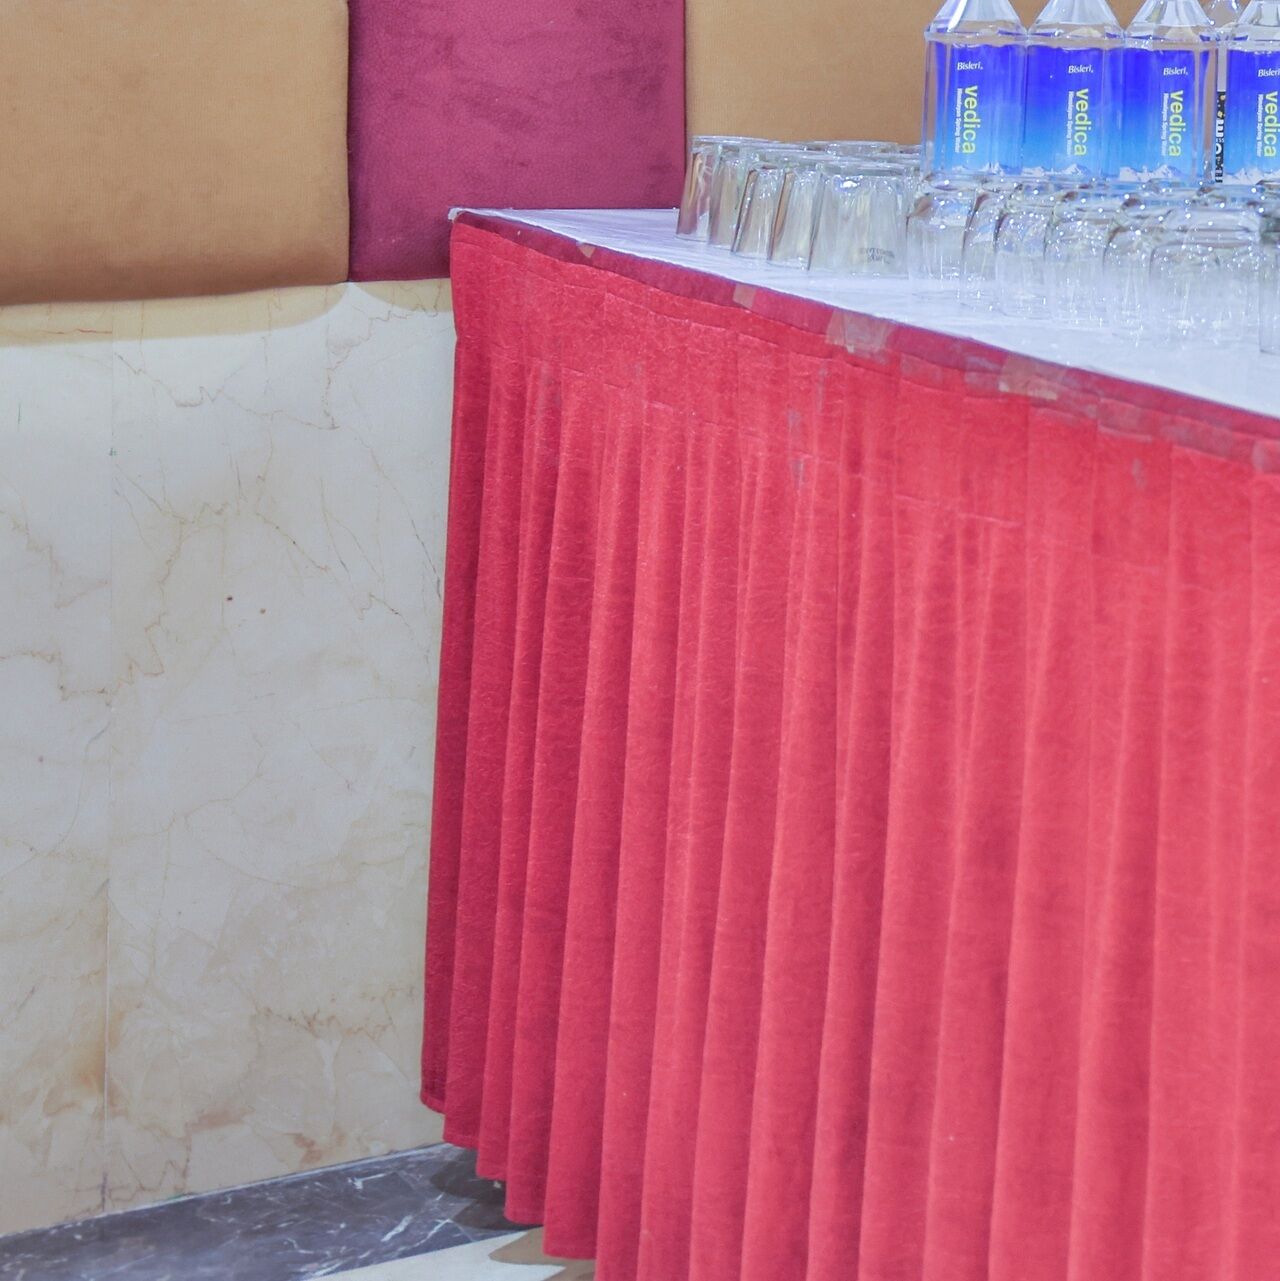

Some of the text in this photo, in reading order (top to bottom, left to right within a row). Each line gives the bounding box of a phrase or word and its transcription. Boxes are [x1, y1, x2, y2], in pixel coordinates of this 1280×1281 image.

[957, 61, 981, 70] Bisleri
[1068, 64, 1091, 73] Bisleri
[1163, 67, 1186, 76] Bisleri
[1258, 68, 1280, 77] Bisleri
[962, 85, 981, 154] vedica
[1073, 88, 1091, 156] vedica
[1168, 90, 1186, 157] vedica
[1263, 91, 1280, 157] vedica
